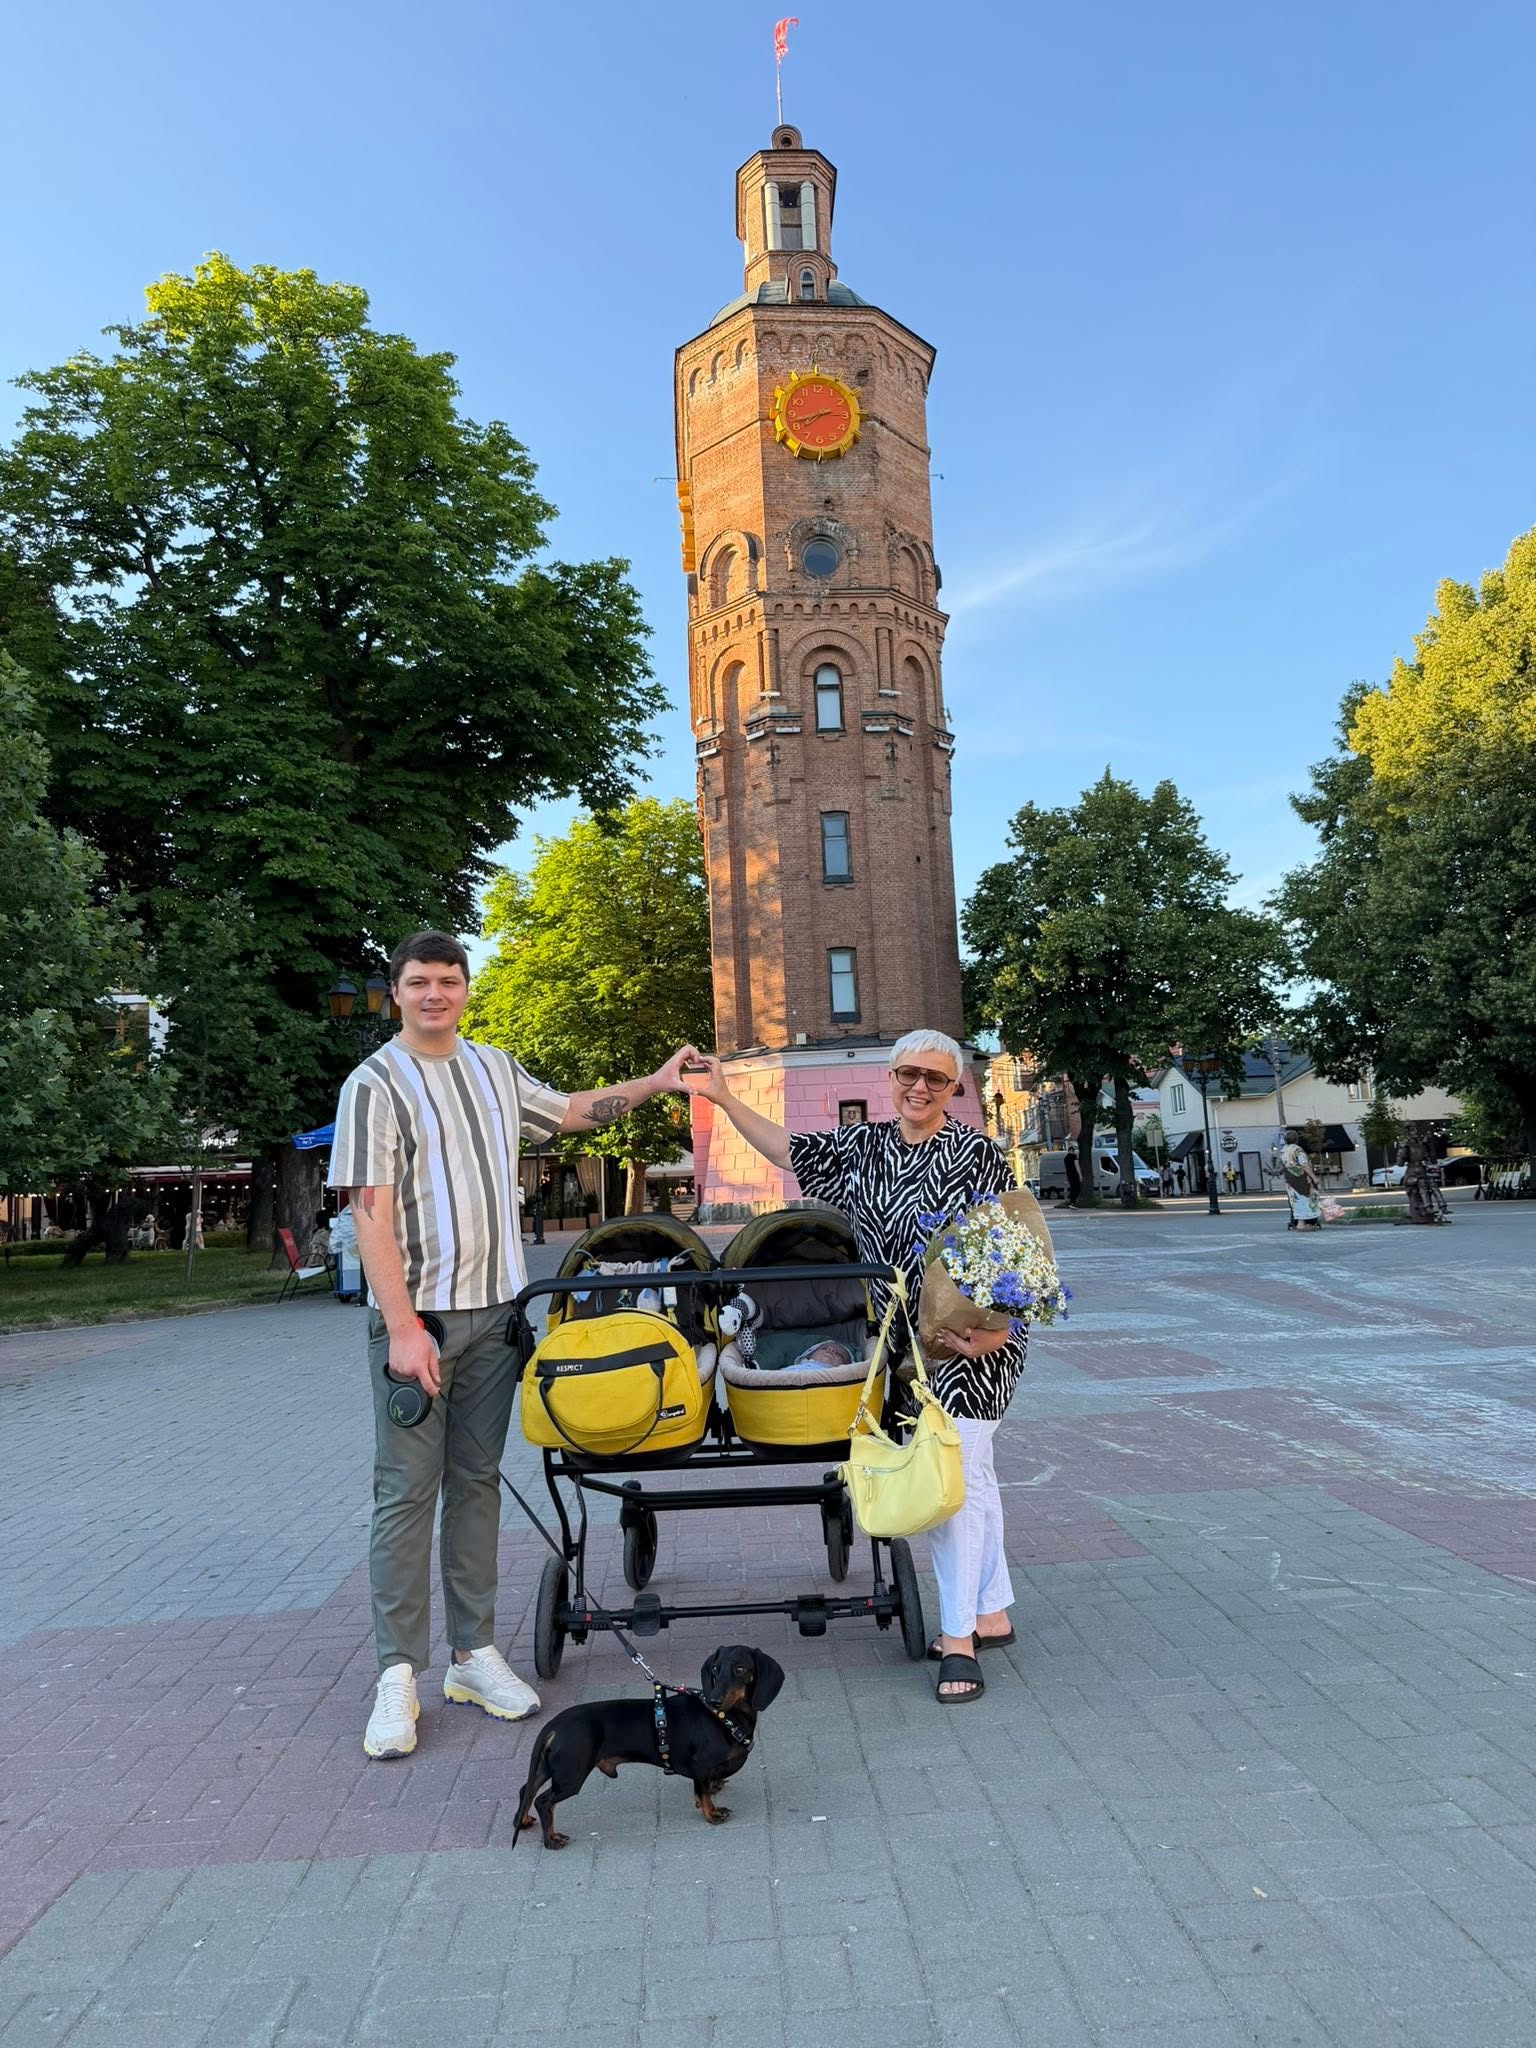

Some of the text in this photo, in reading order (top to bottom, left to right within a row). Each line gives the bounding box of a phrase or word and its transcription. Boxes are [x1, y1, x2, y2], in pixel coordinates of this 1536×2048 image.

[802, 388, 808, 396] 11
[813, 385, 823, 393] 12
[792, 398, 804, 406] 10
[837, 398, 845, 406] 2
[788, 410, 796, 418] 9
[841, 411, 849, 419] 3
[803, 431, 811, 440] 7
[816, 436, 824, 444] 6
[556, 1364, 583, 1372] RESPECT
